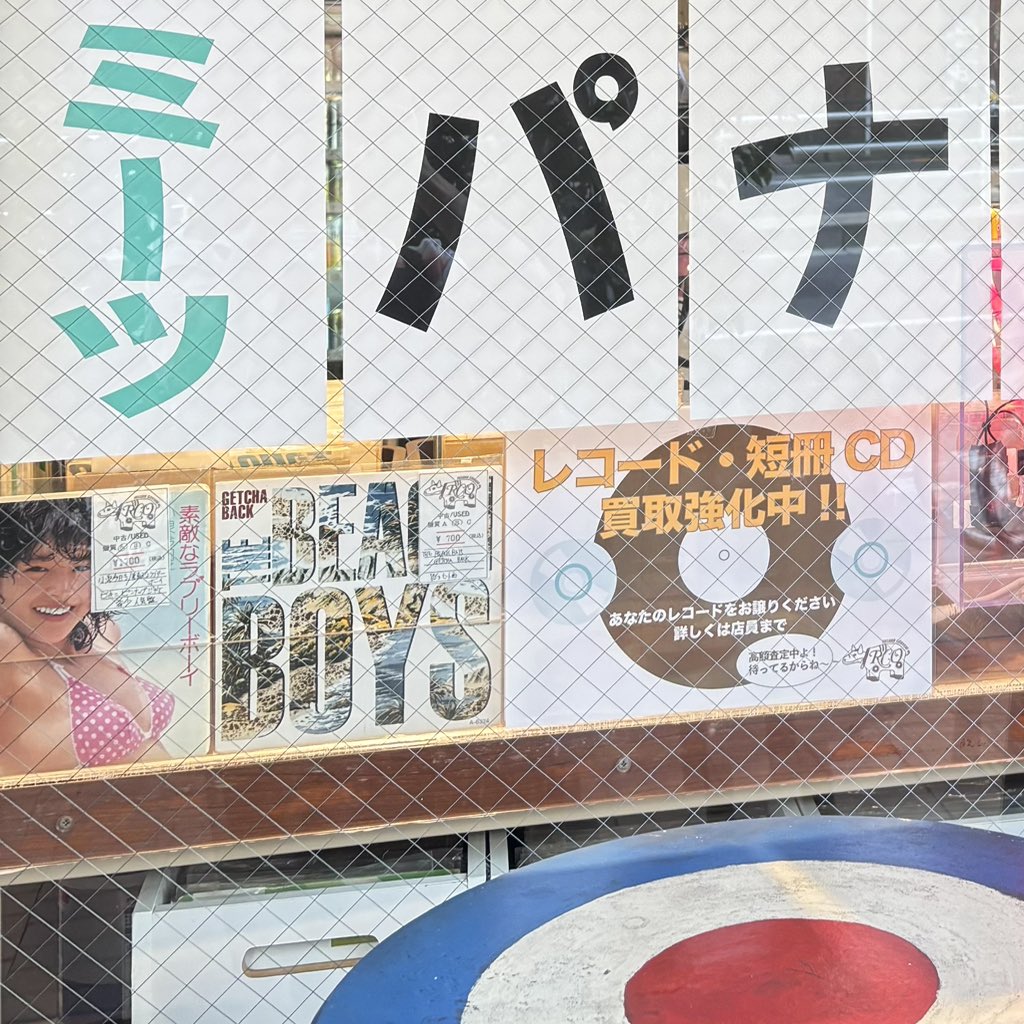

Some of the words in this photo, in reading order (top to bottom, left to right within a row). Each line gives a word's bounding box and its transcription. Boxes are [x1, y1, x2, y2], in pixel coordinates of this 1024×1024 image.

[51, 24, 228, 419] ミーツ
[532, 432, 836, 494] レコード・短冊
[844, 429, 917, 473] CD
[221, 489, 268, 506] GETCHA
[221, 504, 254, 520] BACK
[178, 504, 205, 687] 素敵なラブリーボーイ
[608, 596, 837, 628] あなたのレコードをお譲りください
[673, 618, 788, 642] 詳しくは店員まで
[221, 580, 493, 742] BOYS
